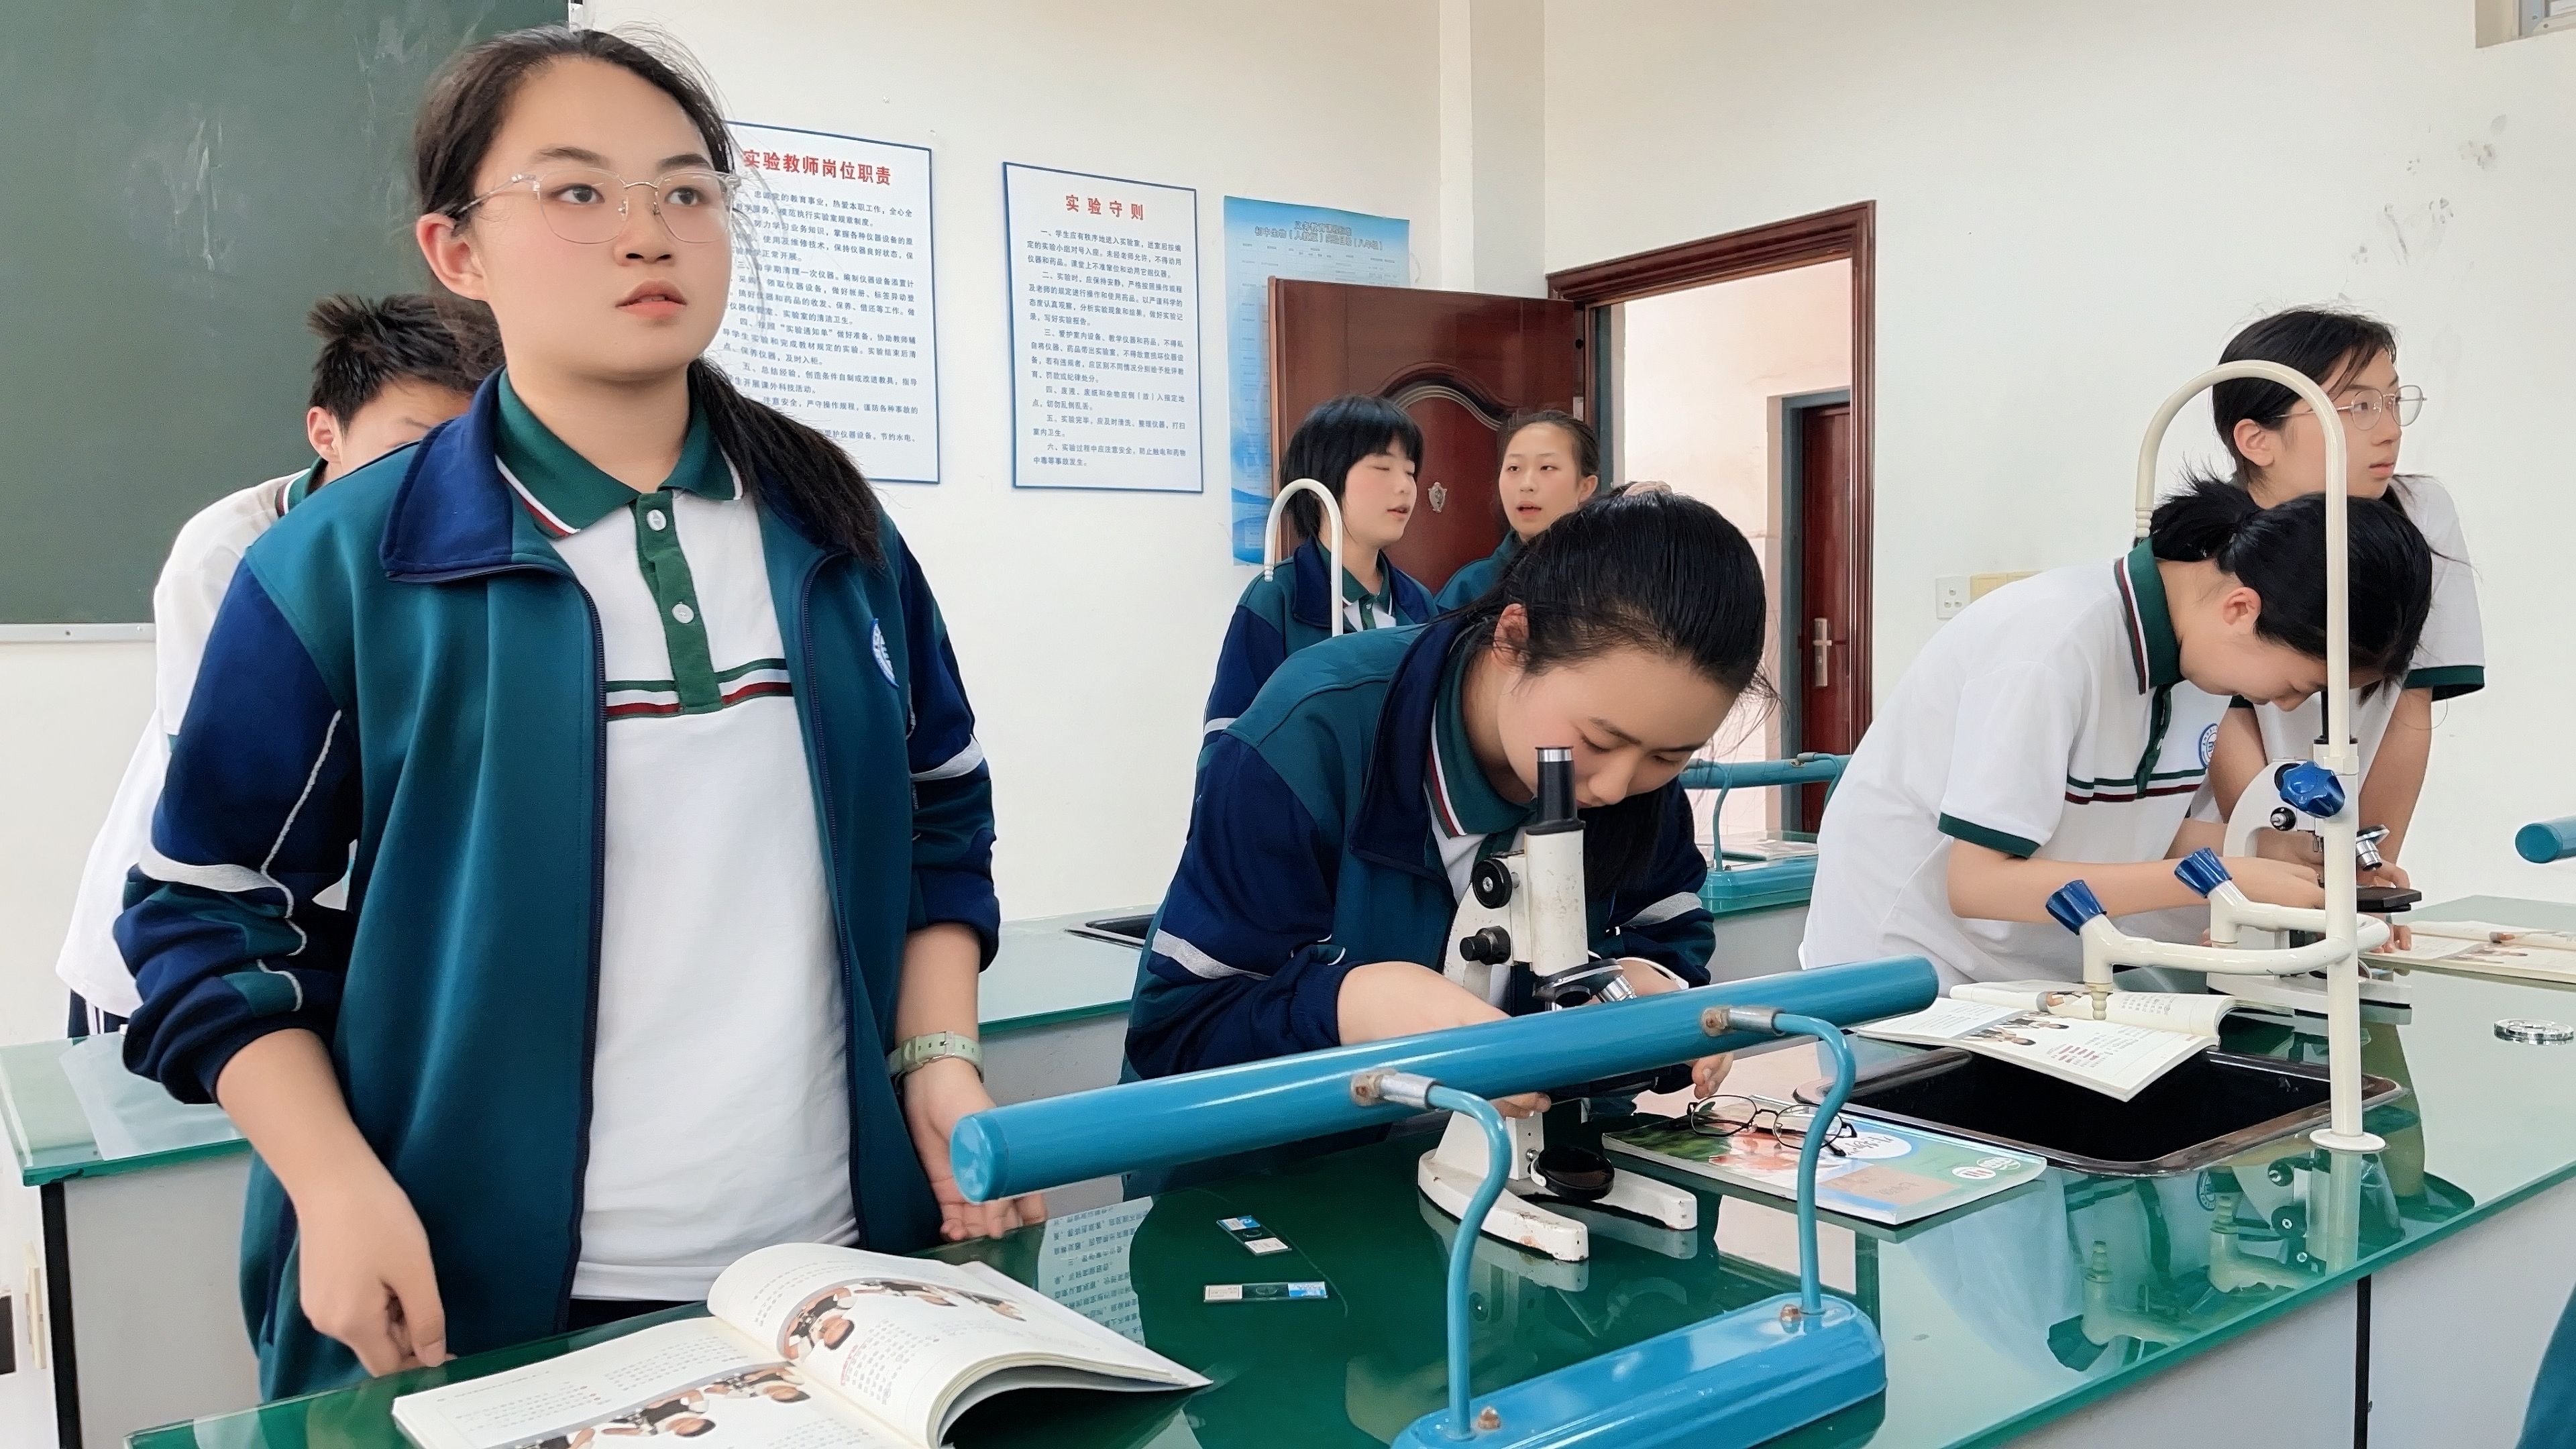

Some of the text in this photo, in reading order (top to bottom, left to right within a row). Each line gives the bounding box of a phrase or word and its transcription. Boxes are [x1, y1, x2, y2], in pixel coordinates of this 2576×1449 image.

[743, 147, 891, 186] 实验教师岗位职责
[1065, 193, 1143, 221] 实验守则
